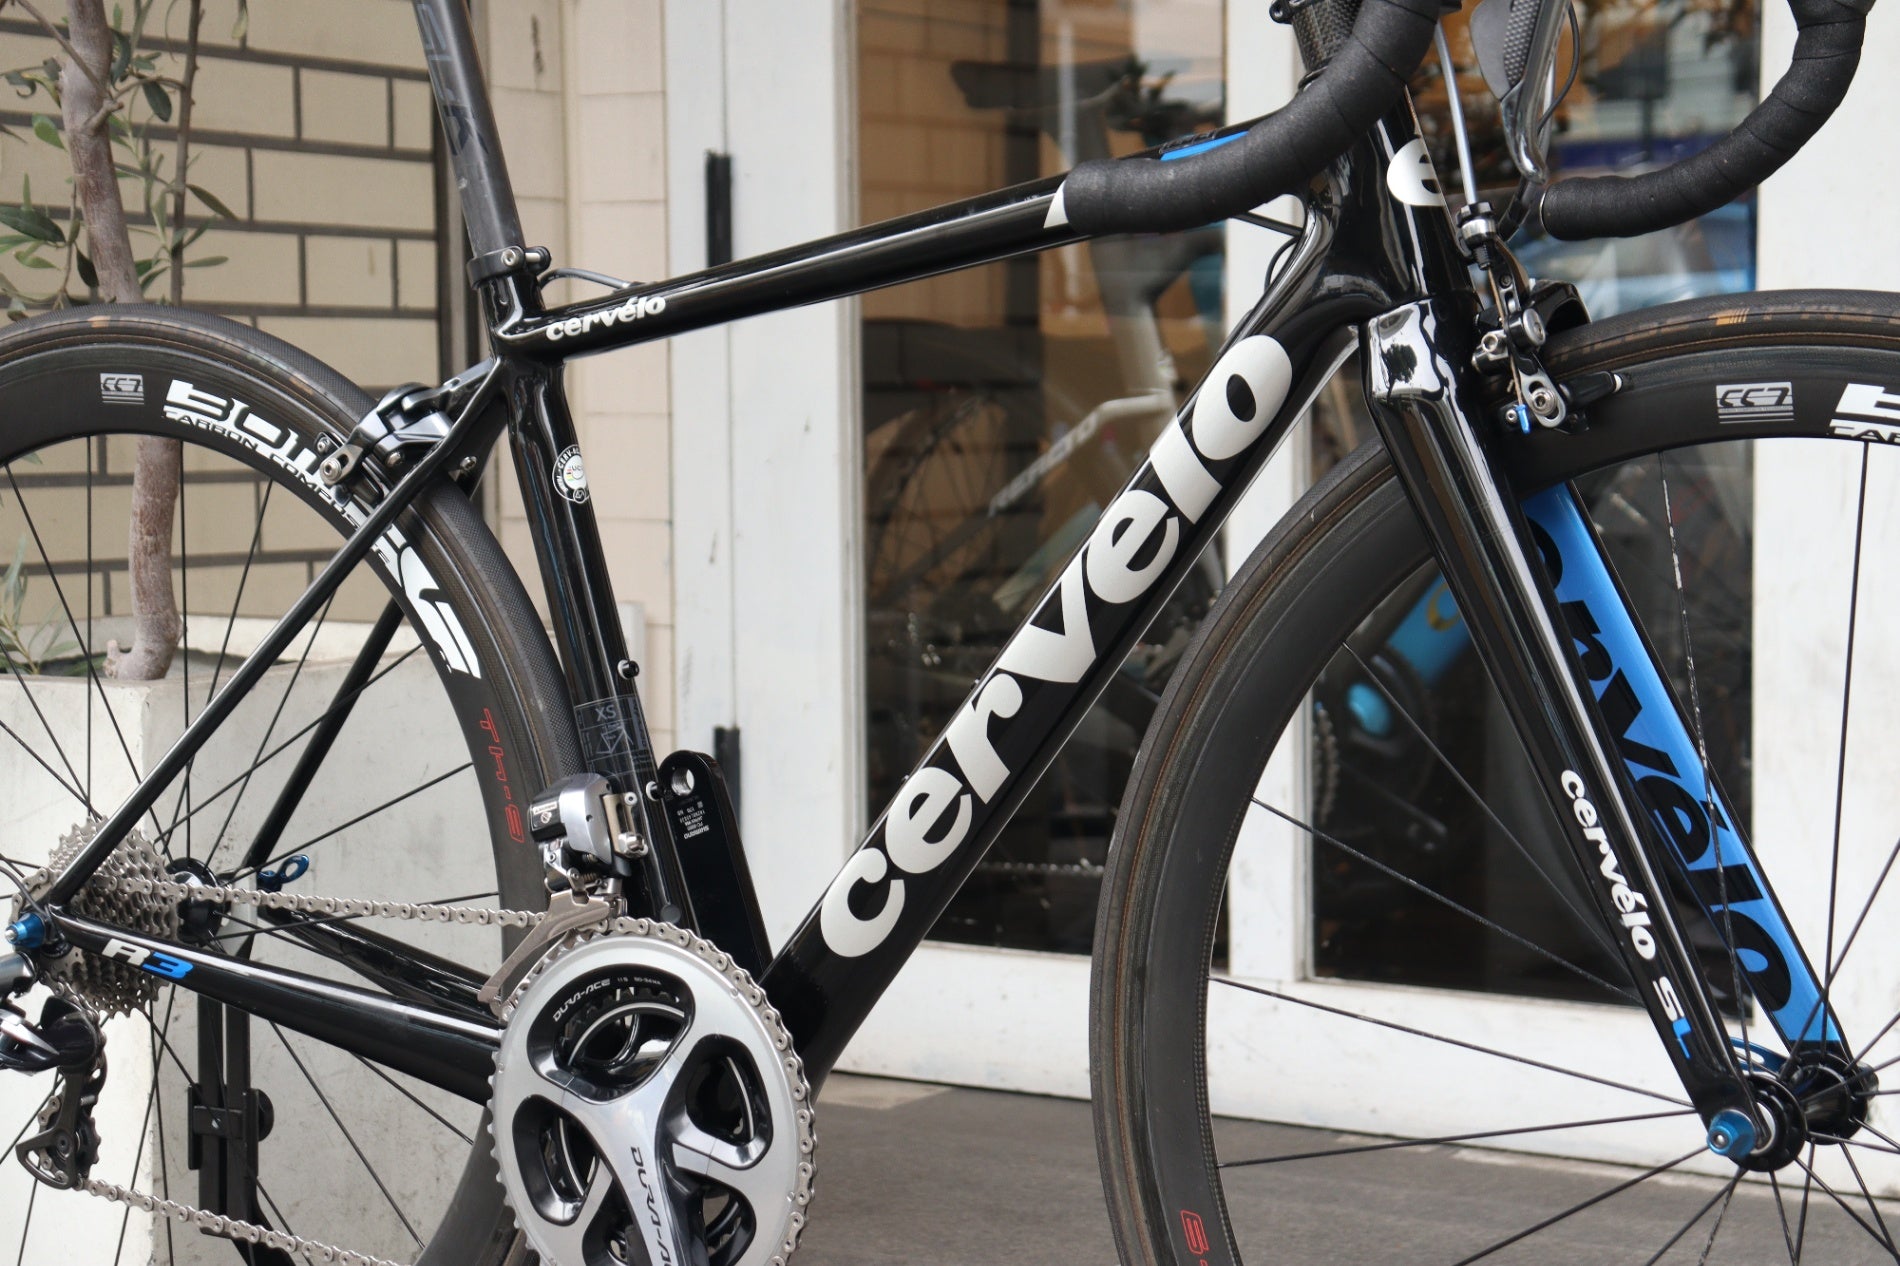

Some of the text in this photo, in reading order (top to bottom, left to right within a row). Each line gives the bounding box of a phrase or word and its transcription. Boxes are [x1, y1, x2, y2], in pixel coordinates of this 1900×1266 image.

[268, 452, 391, 564] COMPOSE
[594, 704, 617, 722] XS
[1561, 769, 1691, 1060] cervélo SL
[101, 938, 194, 979] R3
[553, 978, 611, 1022] DURA-ACE
[630, 1146, 673, 1266] DURA-A
